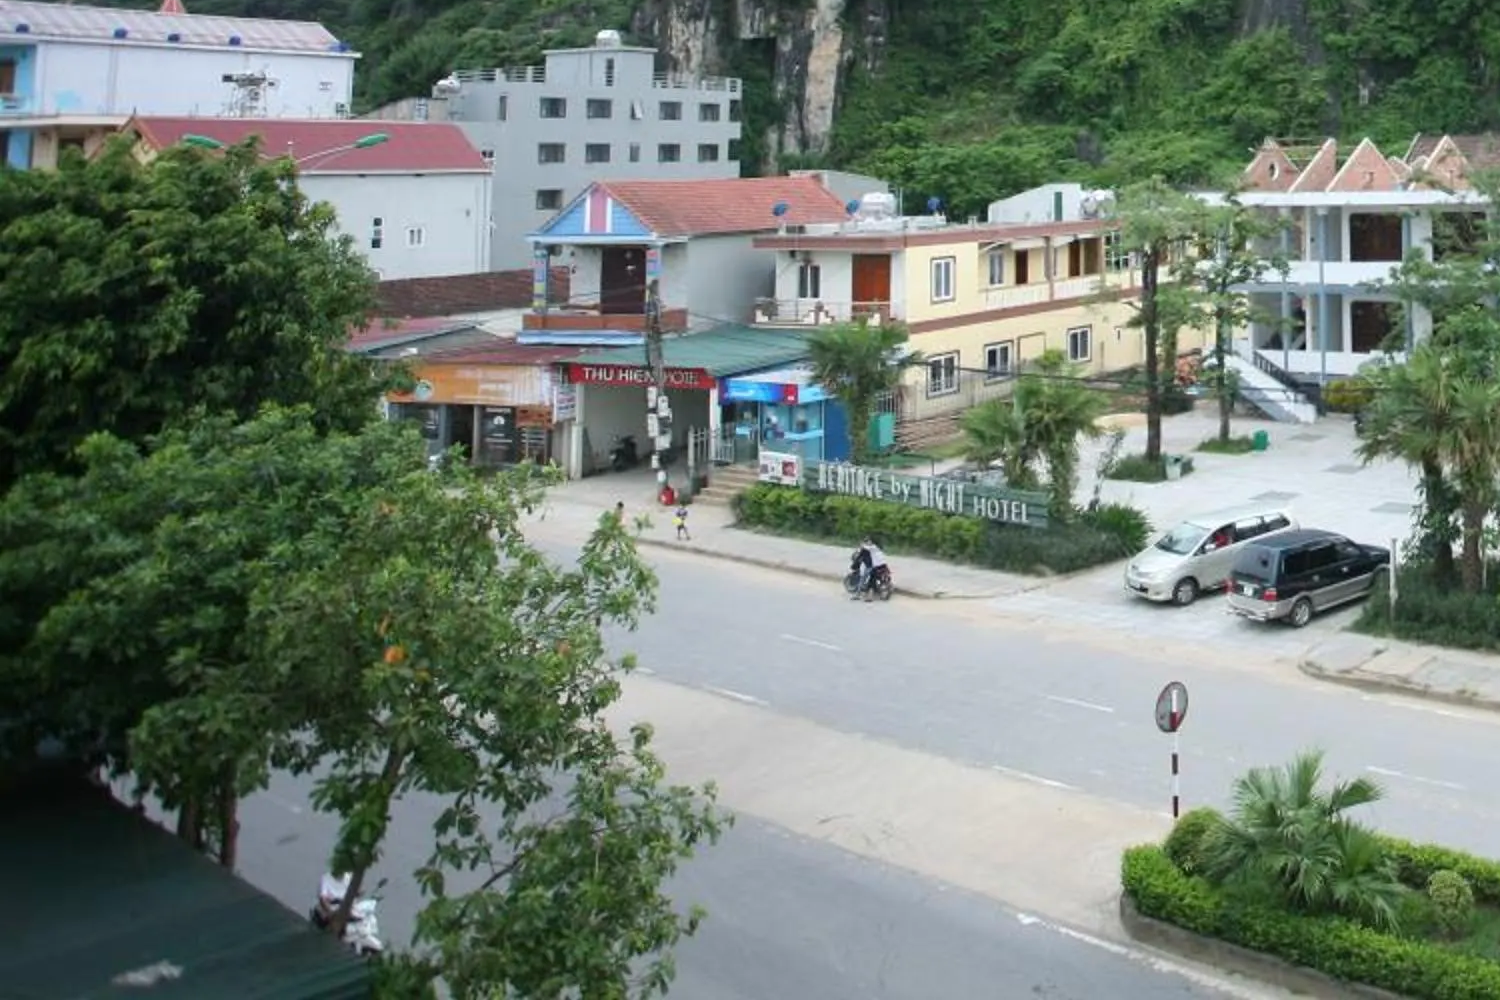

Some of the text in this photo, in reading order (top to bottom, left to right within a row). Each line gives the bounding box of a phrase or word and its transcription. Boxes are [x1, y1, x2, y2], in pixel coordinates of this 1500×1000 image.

[817, 462, 1029, 524] HERITAGE by NIGHT HOTEL
